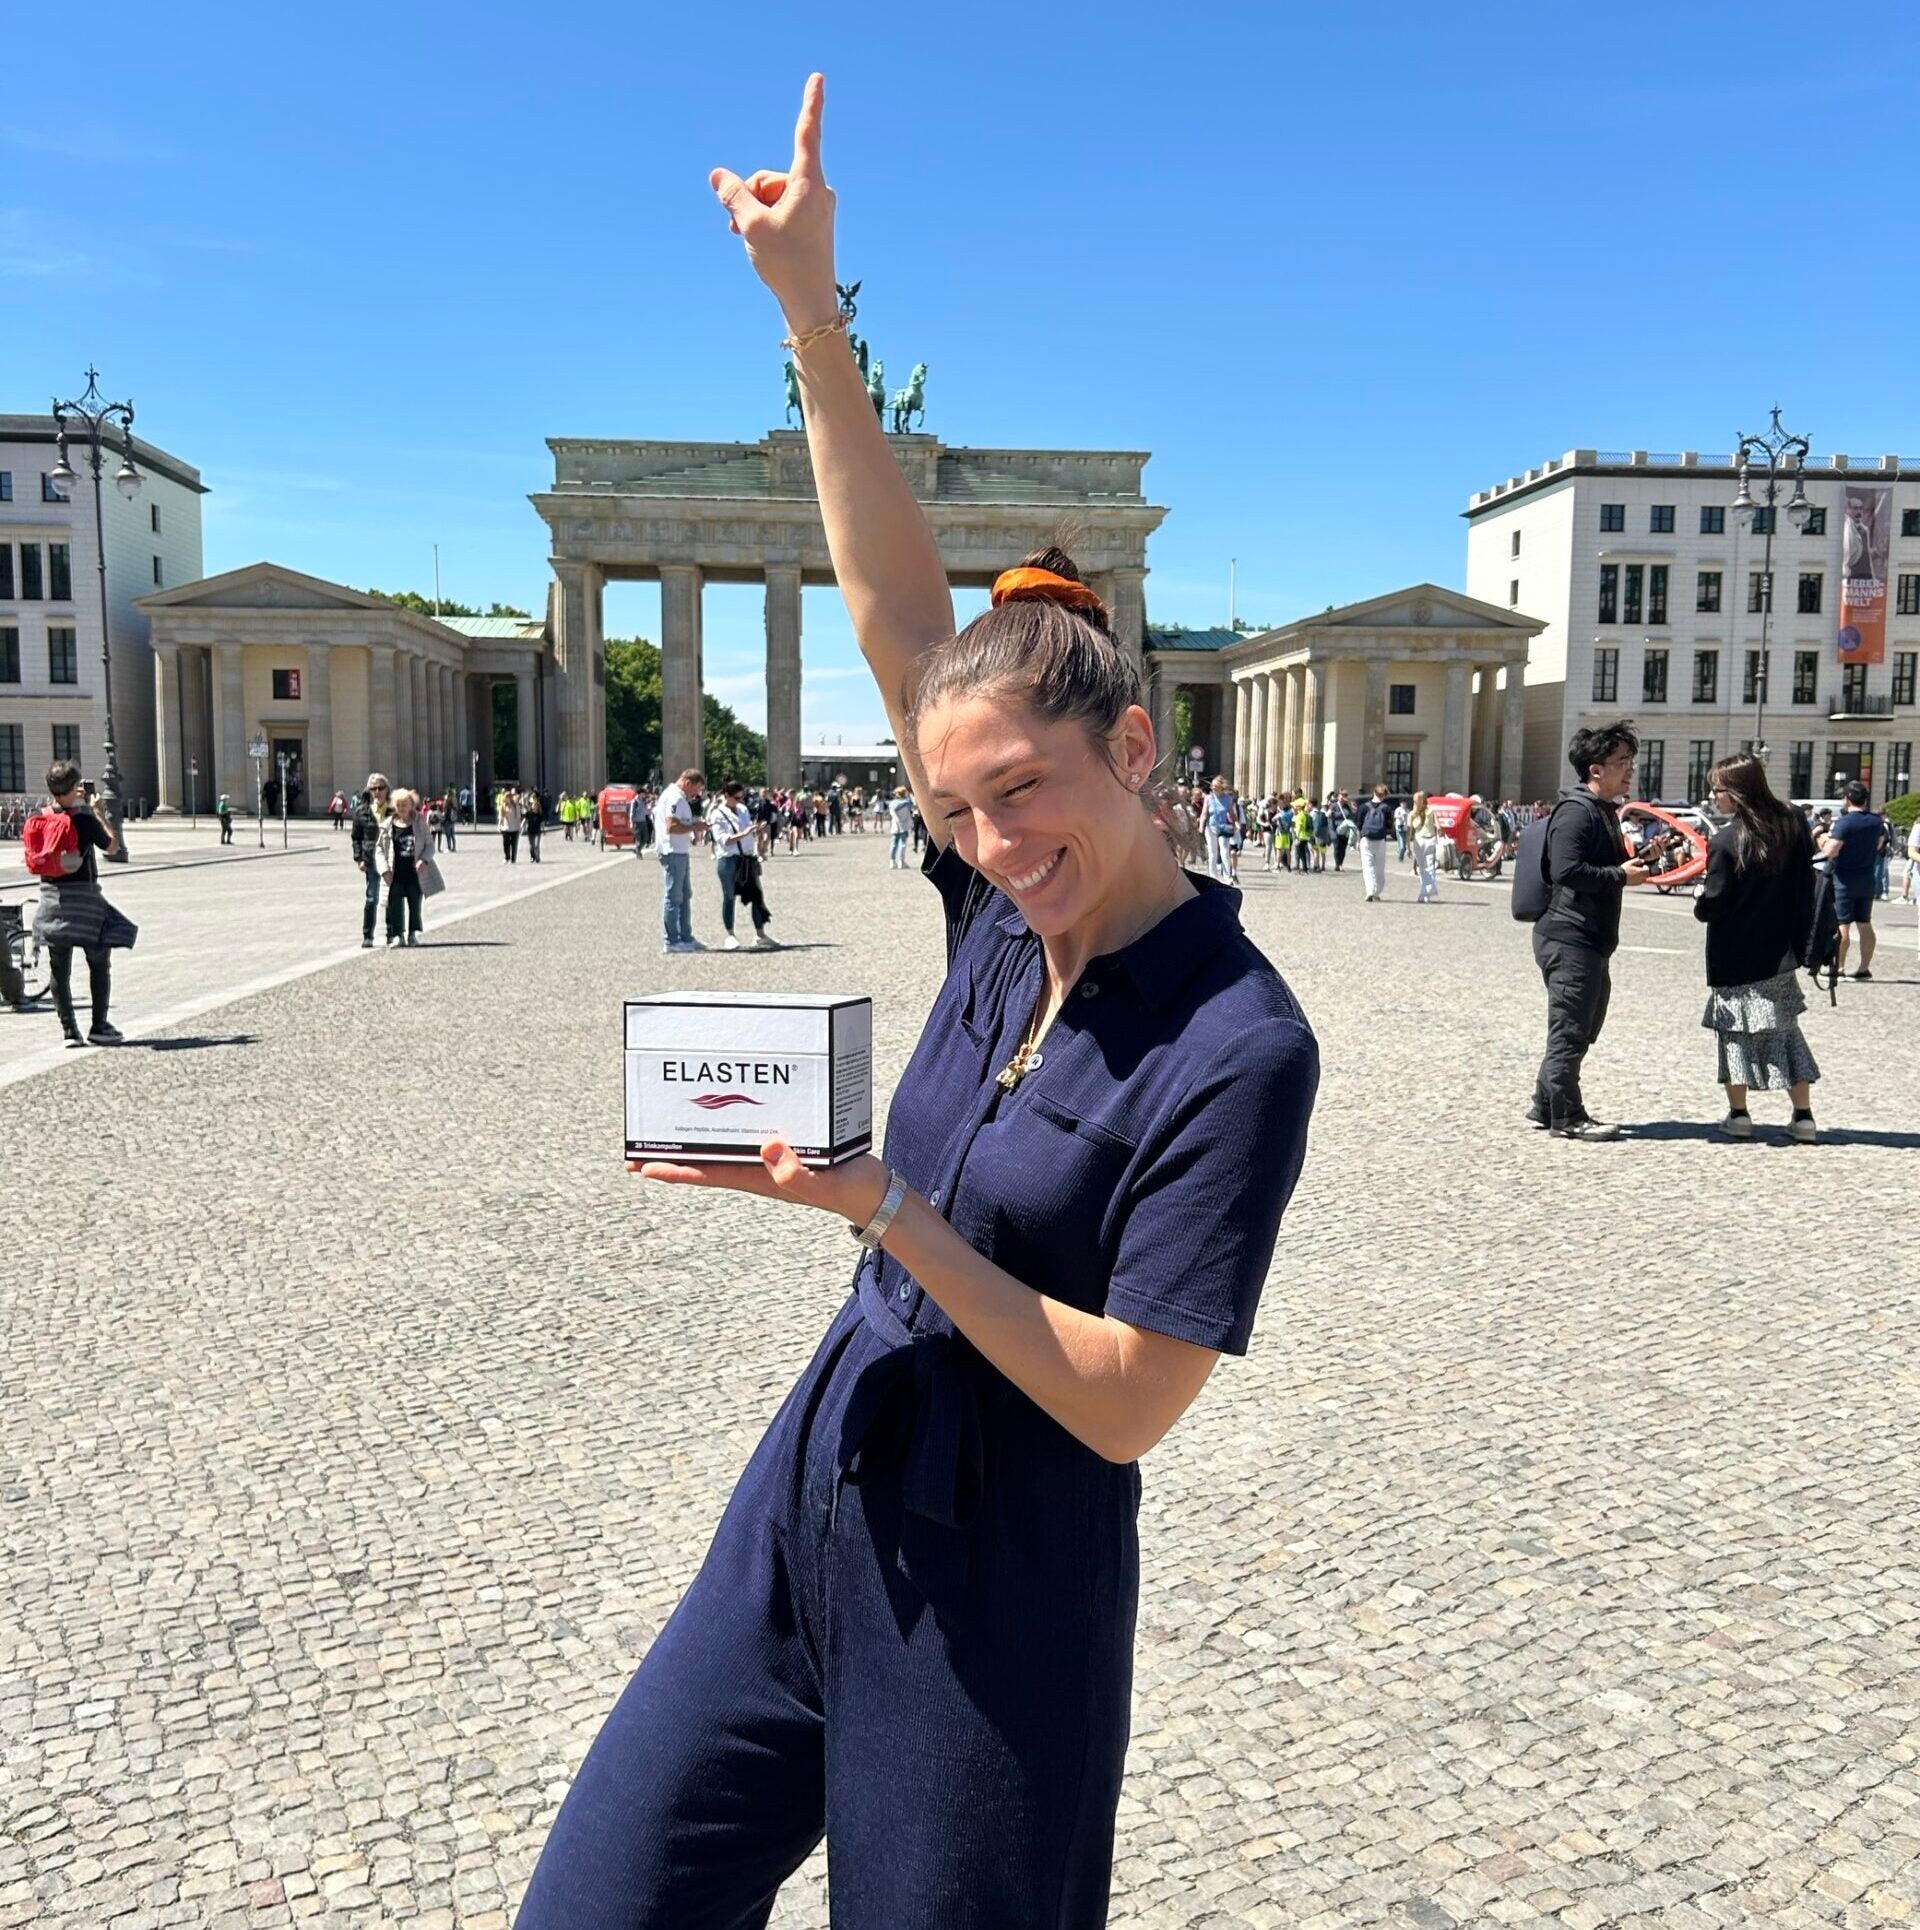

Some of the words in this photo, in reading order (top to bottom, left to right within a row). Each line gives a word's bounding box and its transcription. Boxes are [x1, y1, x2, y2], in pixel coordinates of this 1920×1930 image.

[1841, 578, 1885, 588] LIEBER-
[1842, 588, 1885, 598] MANNS
[1842, 598, 1873, 607] WELT
